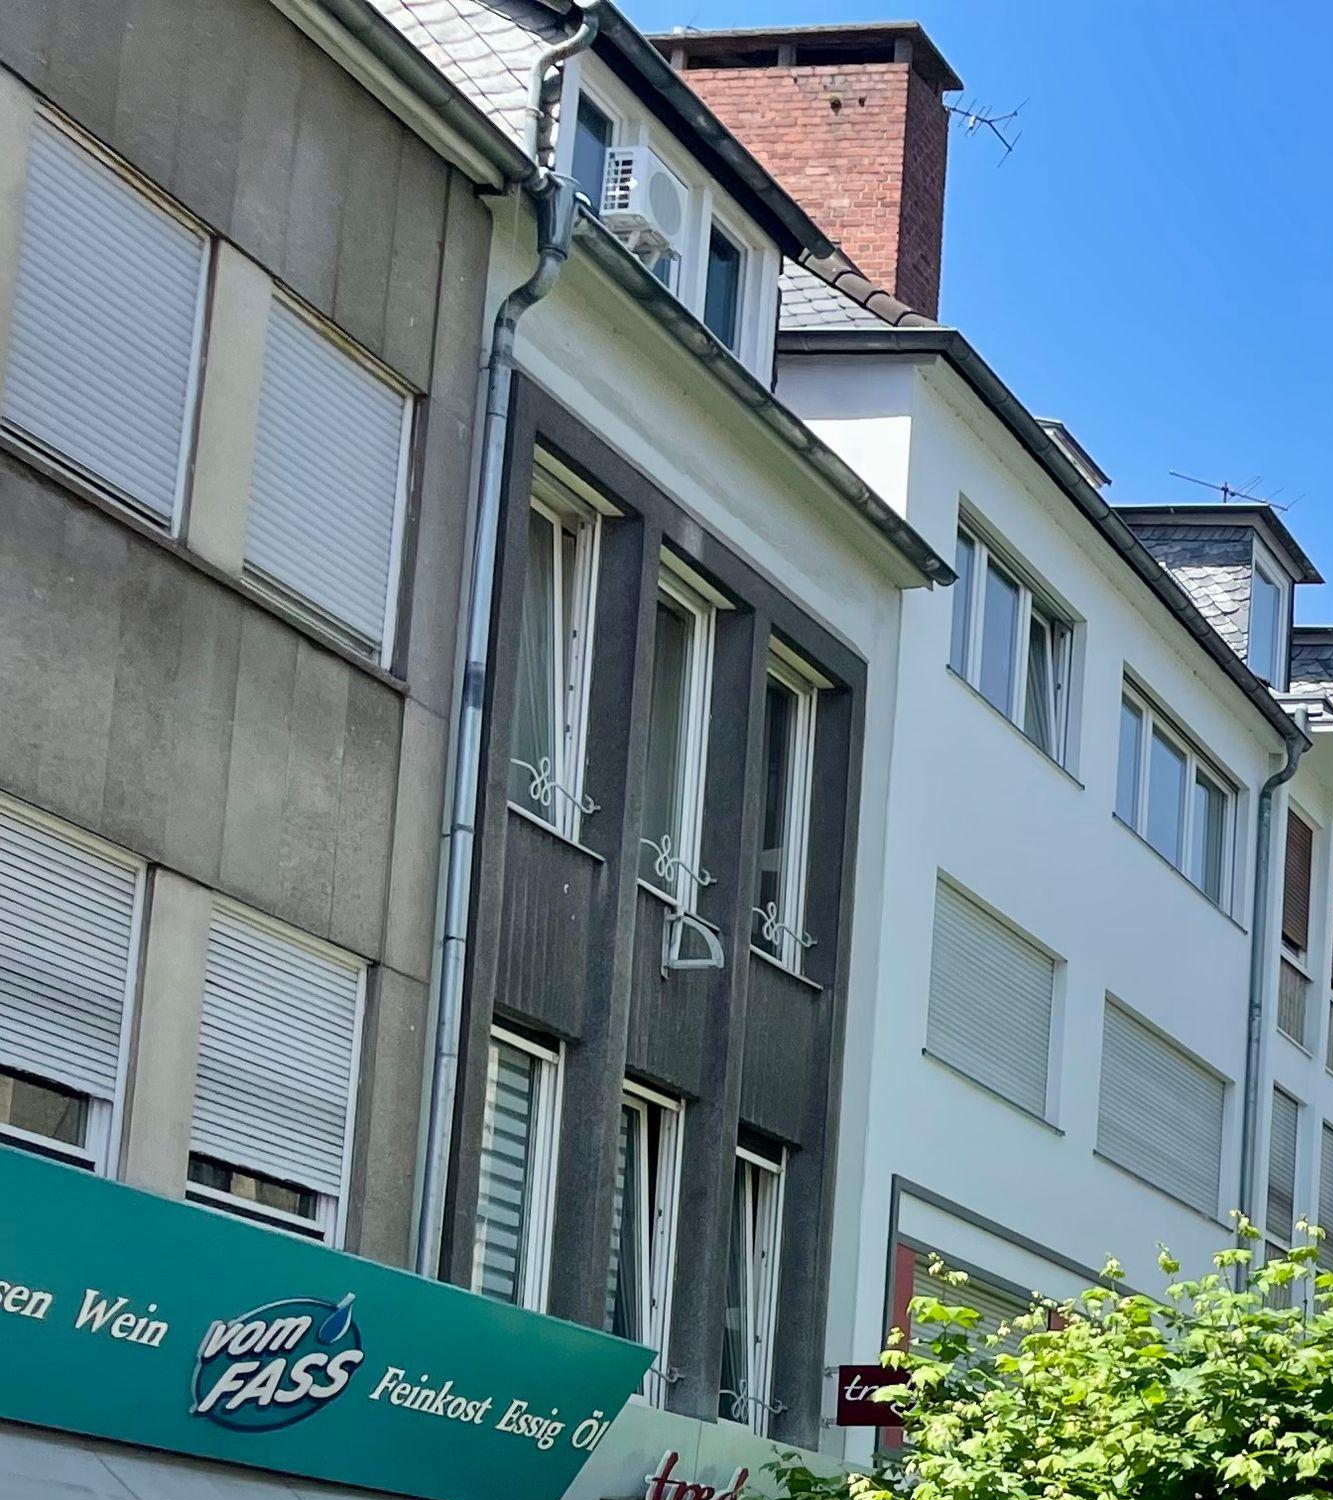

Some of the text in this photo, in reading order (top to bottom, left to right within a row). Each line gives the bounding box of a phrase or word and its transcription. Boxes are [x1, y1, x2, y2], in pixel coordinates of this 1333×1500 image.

[75, 1288, 168, 1347] Wein
[203, 1315, 312, 1359] vom
[197, 1349, 364, 1413] FASS
[369, 1366, 610, 1452] Feinkost Essig Öl
